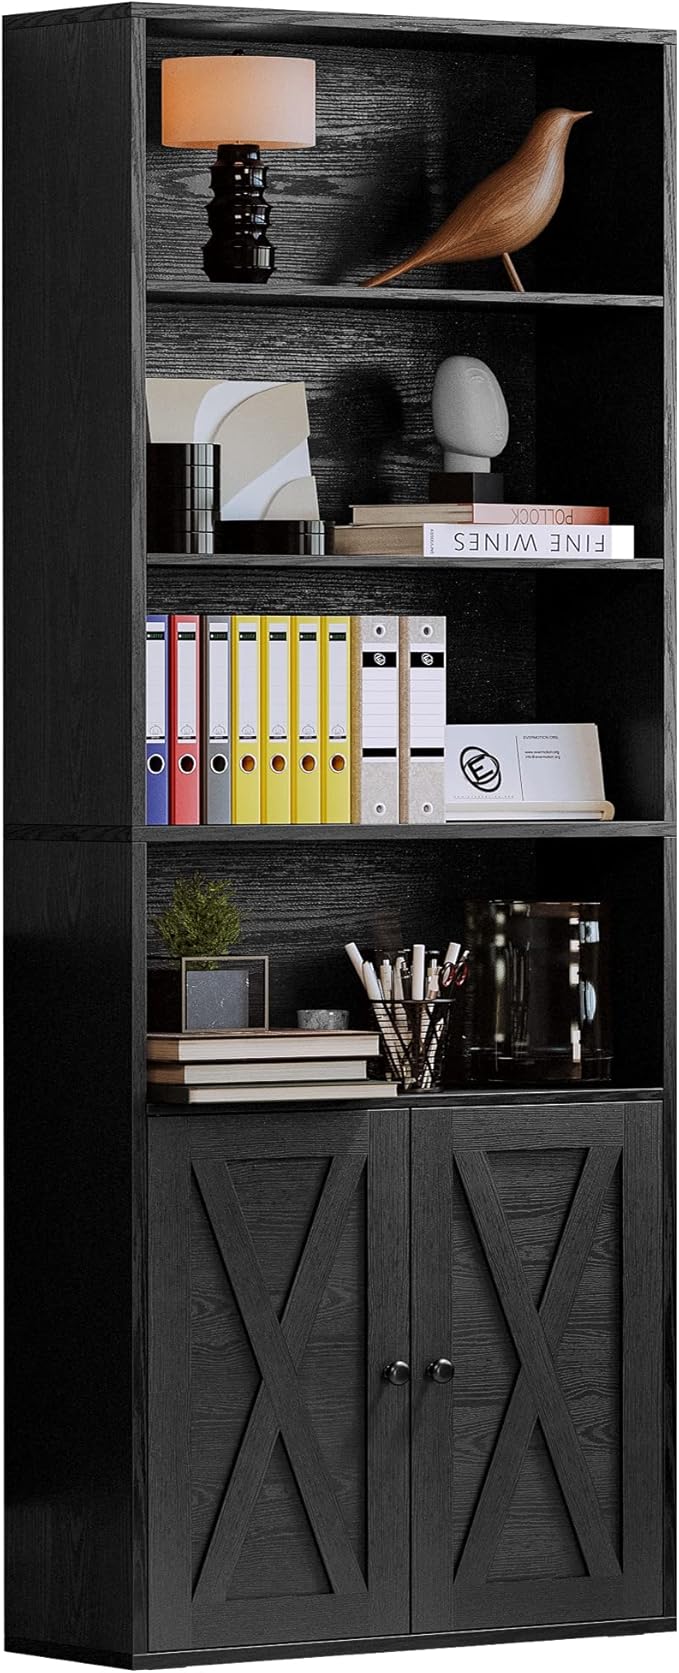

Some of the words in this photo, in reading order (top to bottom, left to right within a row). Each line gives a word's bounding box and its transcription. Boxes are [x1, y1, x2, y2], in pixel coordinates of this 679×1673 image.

[511, 508, 574, 525] POLLOCK
[453, 532, 538, 552] WINES
[550, 534, 605, 553] FINE
